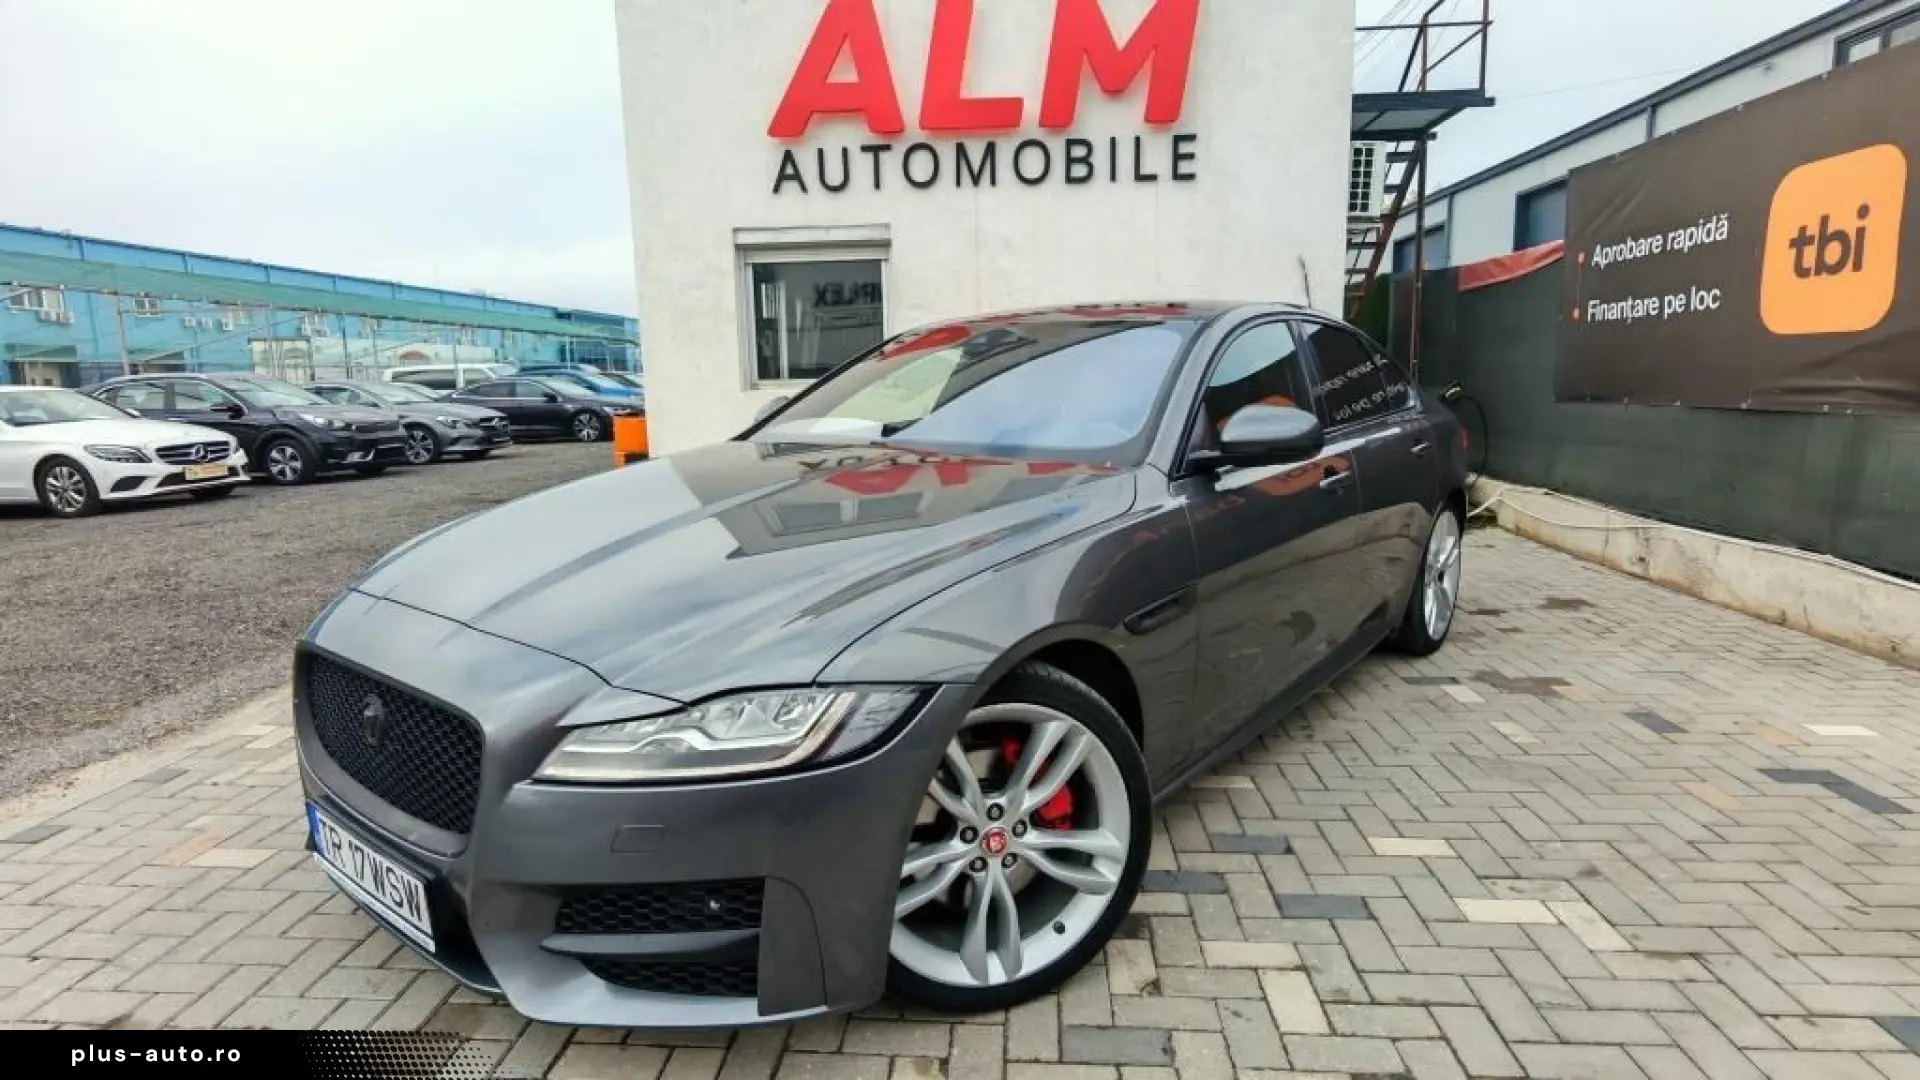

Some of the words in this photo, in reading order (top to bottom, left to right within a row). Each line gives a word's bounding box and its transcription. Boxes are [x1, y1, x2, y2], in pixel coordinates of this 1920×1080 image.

[767, 0, 1199, 138] ALM
[772, 134, 1198, 194] AUTOMOBILE
[1591, 234, 1663, 270] Aprobare
[1666, 213, 1728, 254] rapidă
[1788, 203, 1870, 279] tbi
[1587, 296, 1659, 324] Finanțare
[1664, 292, 1686, 320] pe
[1690, 285, 1720, 312] loc
